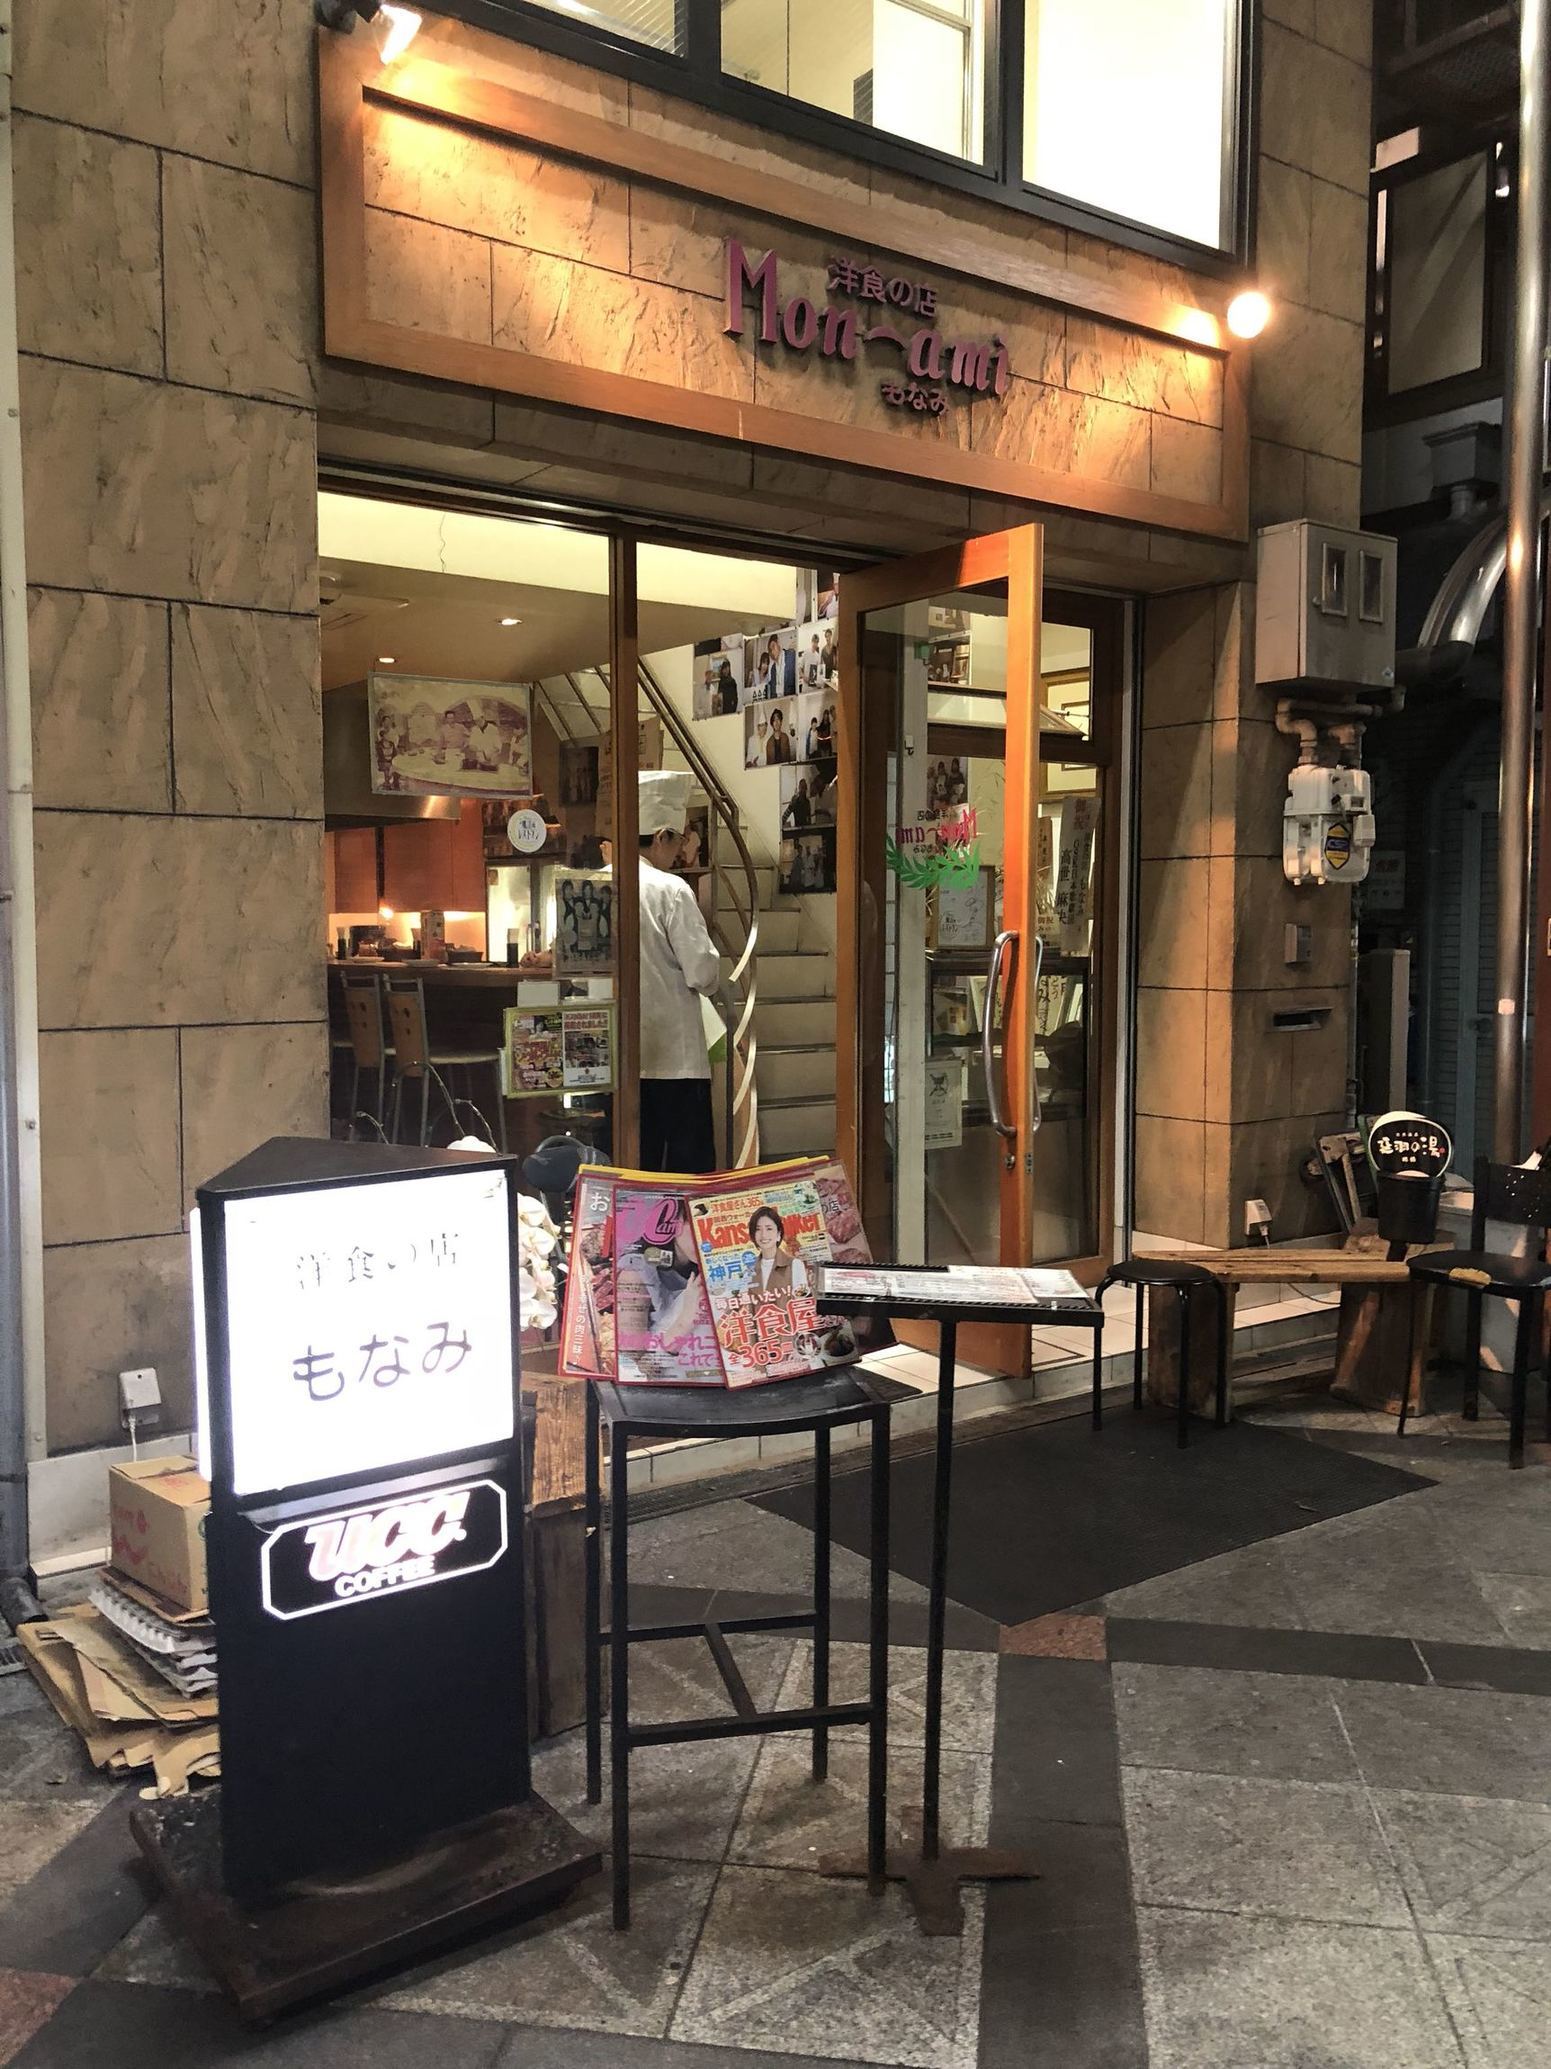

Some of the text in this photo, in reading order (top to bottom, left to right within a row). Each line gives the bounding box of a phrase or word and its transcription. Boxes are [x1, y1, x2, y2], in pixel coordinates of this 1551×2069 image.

[827, 257, 938, 317] 洋食の店
[881, 382, 950, 415] もなみ
[292, 1321, 473, 1402] もなみ
[334, 1555, 436, 1597] COFFEE
